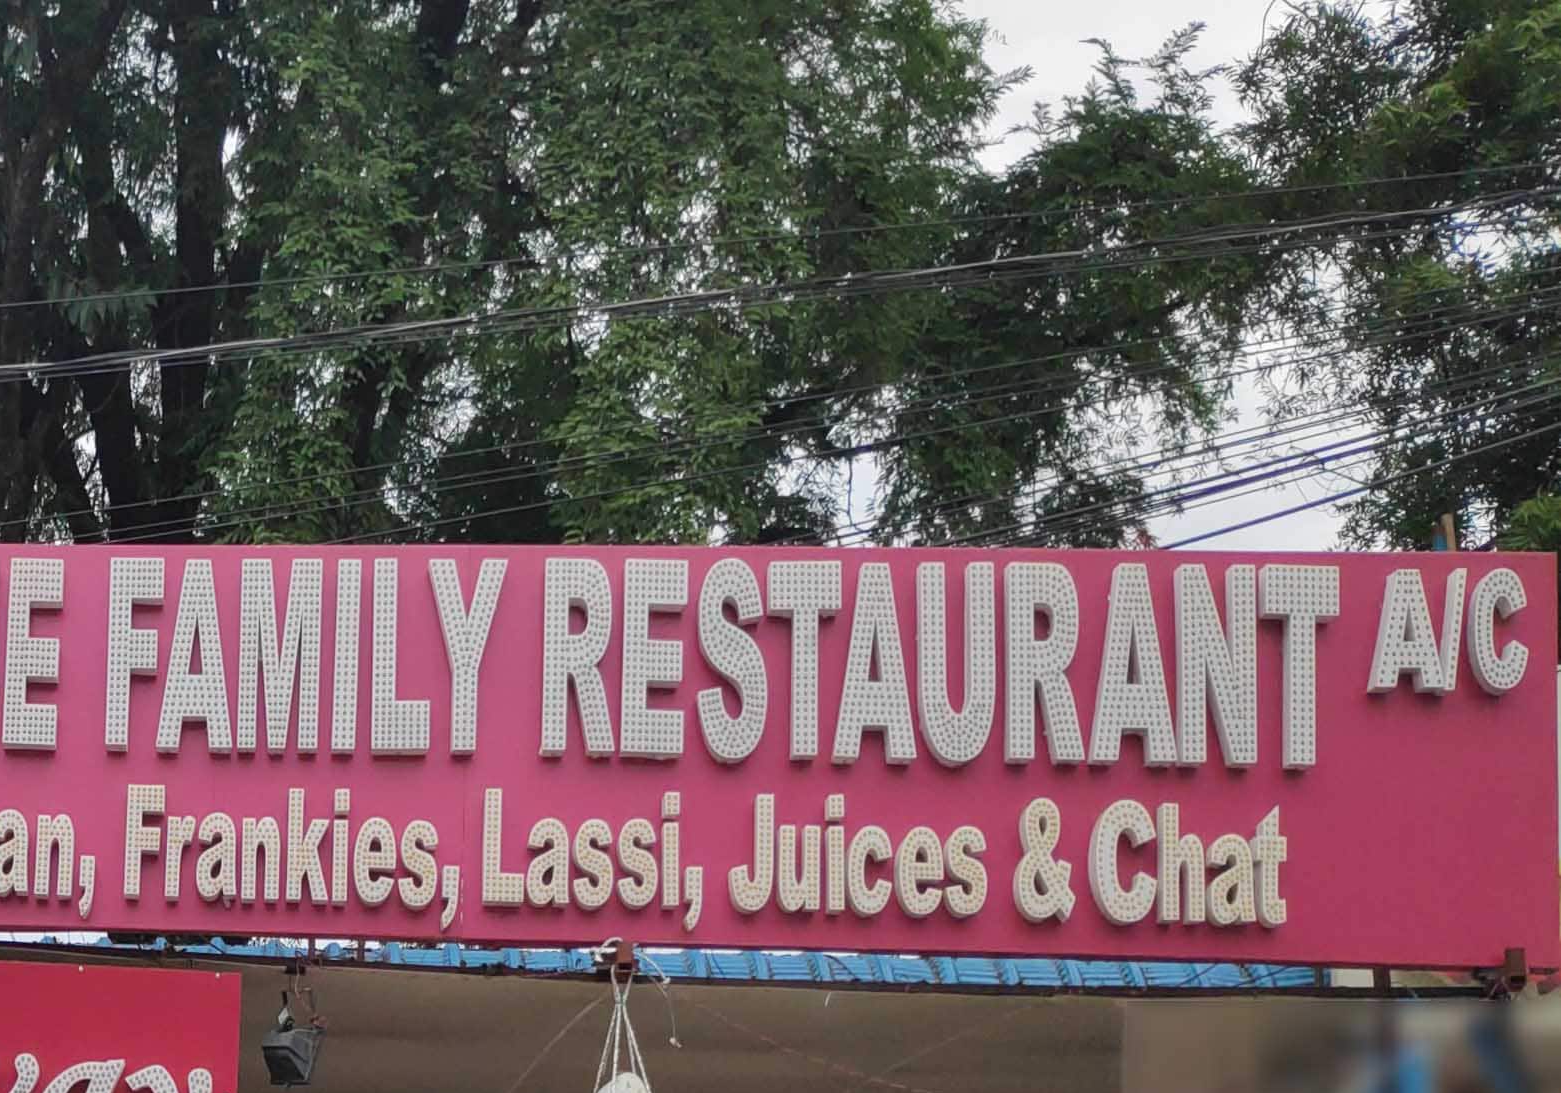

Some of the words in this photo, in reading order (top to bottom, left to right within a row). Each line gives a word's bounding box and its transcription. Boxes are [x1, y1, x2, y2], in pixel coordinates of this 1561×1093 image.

[104, 557, 508, 757] FAMILY
[539, 557, 1340, 771] RESTAURANT
[1367, 567, 1530, 696] A/C
[124, 784, 460, 931] Frankies,
[482, 788, 703, 931] Lassi,
[728, 793, 988, 918] Juices
[1013, 796, 1076, 924] &
[1088, 798, 1288, 930] Chat
